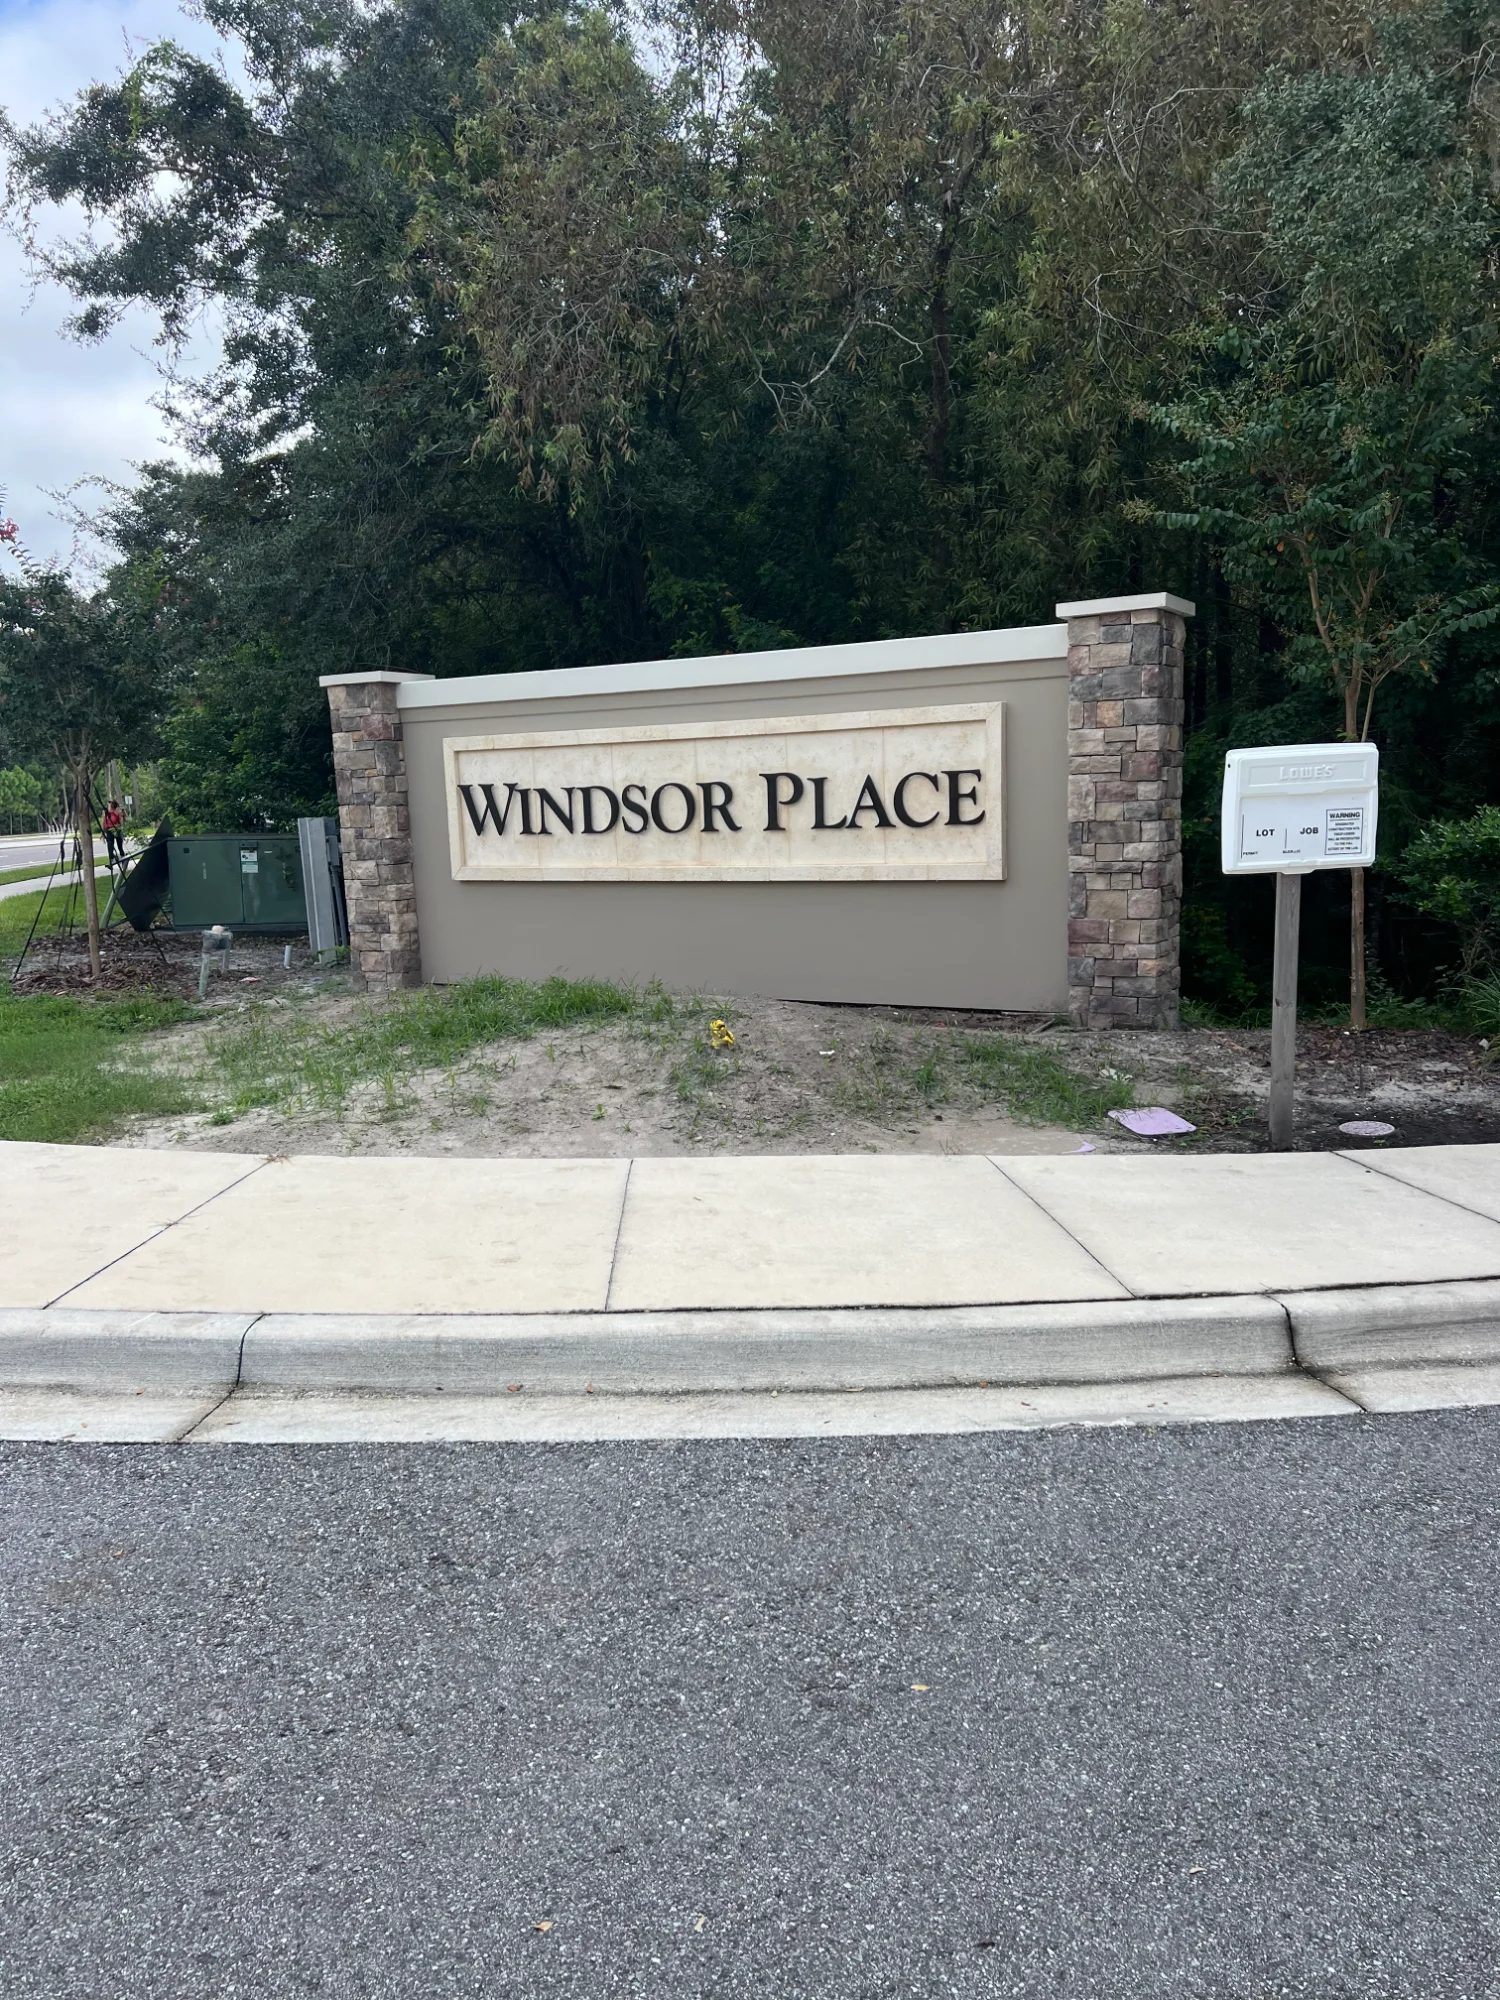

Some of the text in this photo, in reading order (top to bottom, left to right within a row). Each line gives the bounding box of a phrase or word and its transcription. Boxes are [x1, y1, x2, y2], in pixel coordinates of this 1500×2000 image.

[1279, 764, 1334, 781] LOWE'S
[458, 769, 986, 836] WINDSOR PLACE
[1329, 811, 1361, 819] WARNING
[1256, 828, 1275, 837] LOT
[1299, 826, 1319, 835] JOB
